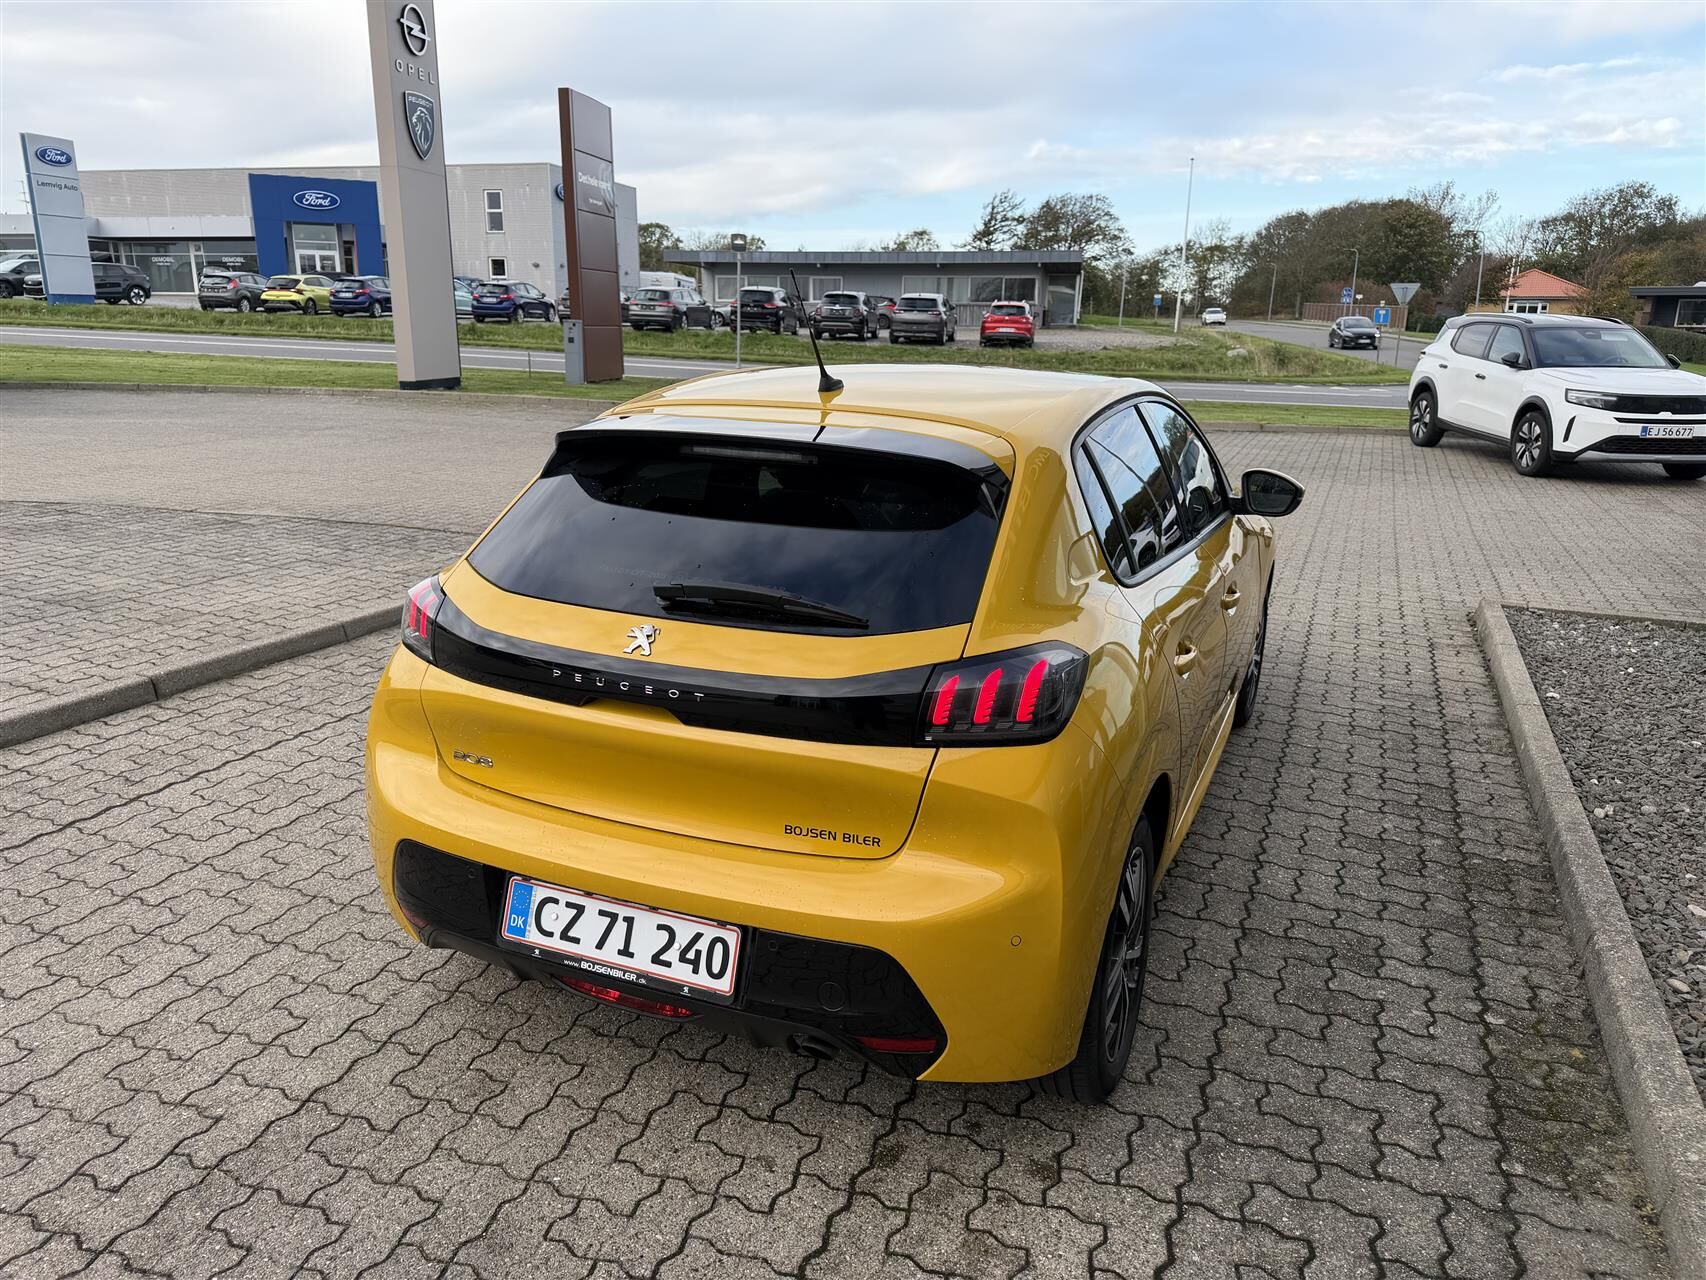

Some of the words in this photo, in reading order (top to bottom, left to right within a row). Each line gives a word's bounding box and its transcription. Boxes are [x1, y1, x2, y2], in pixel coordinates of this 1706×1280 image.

[395, 59, 435, 85] OPEL
[36, 179, 63, 190] Lemvig
[63, 183, 79, 191] Auto
[1647, 427, 1661, 437] EJ
[1662, 427, 1674, 437] 56
[1675, 427, 1693, 437] 677
[552, 668, 705, 703] PEUGEOT
[453, 748, 494, 769] 208
[784, 824, 838, 841] BOJSEN
[842, 832, 881, 847] BILER
[510, 914, 526, 929] DK
[534, 896, 586, 945] CZ
[594, 908, 636, 959] 71
[650, 923, 730, 980] 240
[563, 959, 647, 985] www.BOJSENBILER.dk
